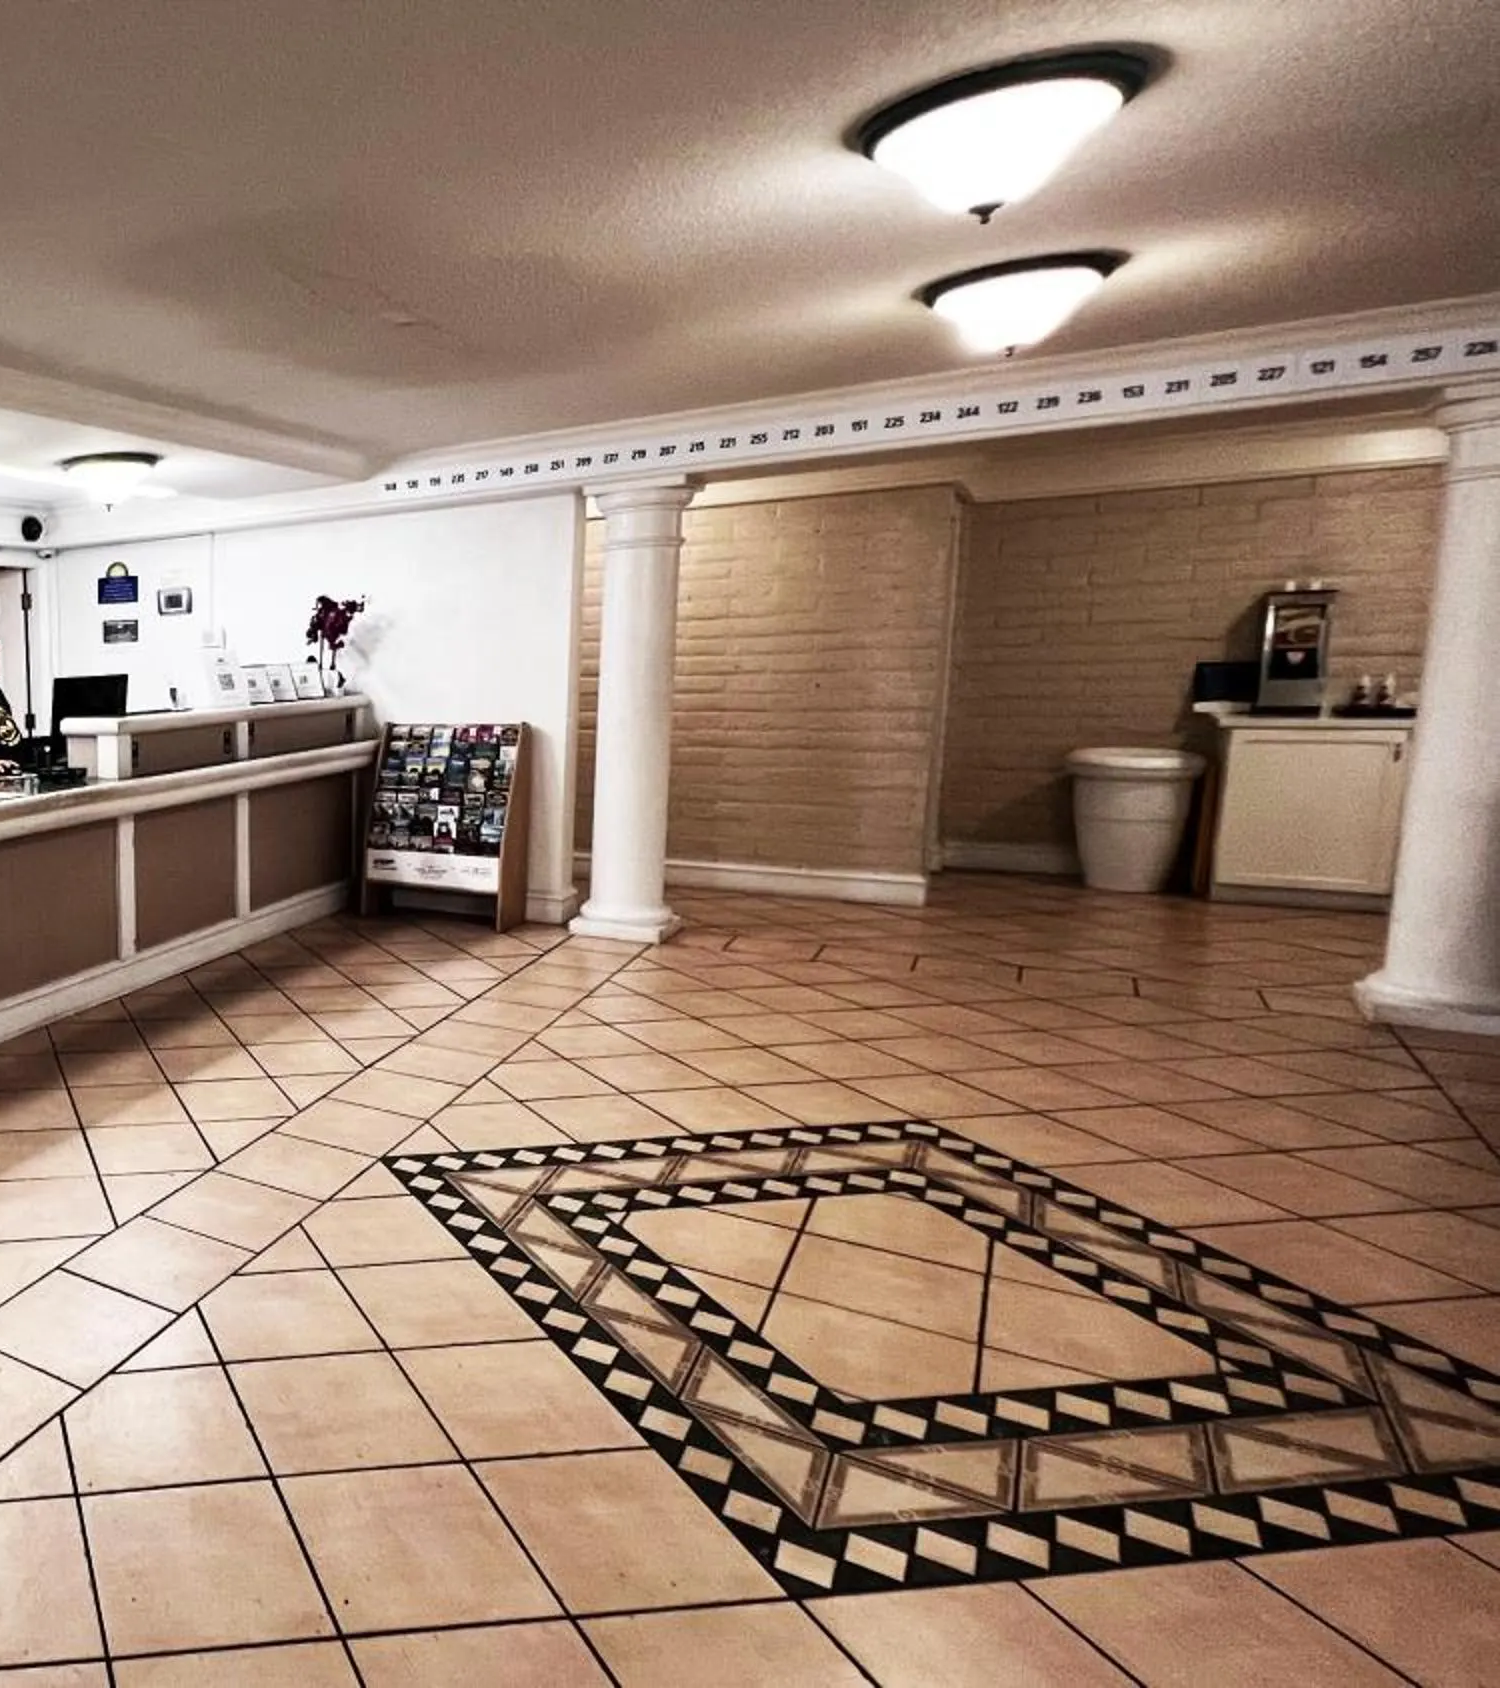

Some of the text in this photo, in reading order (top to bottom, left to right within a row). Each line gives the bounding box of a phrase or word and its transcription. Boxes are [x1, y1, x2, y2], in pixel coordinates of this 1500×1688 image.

[782, 428, 801, 441] 212
[851, 419, 869, 433] 151
[883, 415, 905, 429] 225
[919, 410, 942, 424] 234
[956, 405, 981, 420] 244
[996, 400, 1020, 415] 122
[1256, 365, 1287, 382] 227
[1309, 359, 1336, 376] 121
